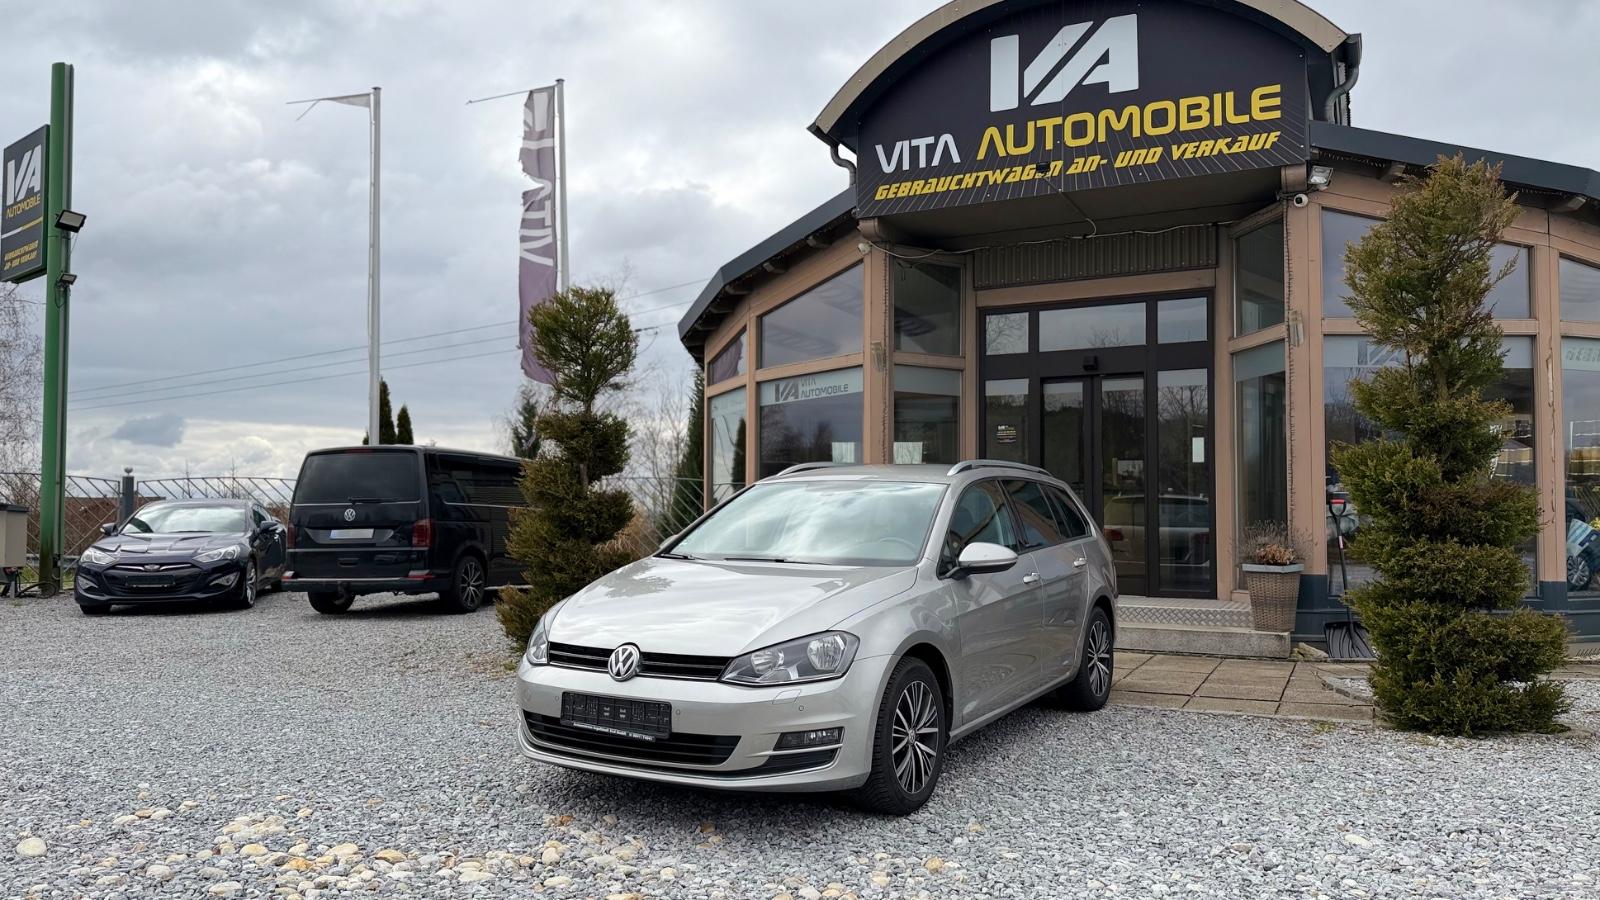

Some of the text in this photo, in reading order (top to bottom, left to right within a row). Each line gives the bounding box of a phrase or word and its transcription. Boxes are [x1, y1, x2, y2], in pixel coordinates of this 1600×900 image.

[875, 84, 1281, 174] VITA AUTOMOBILE
[1172, 131, 1282, 161] VERKAUF
[5, 193, 41, 219] AUTOMOBILE
[801, 383, 849, 398] AUTOMOBILE
